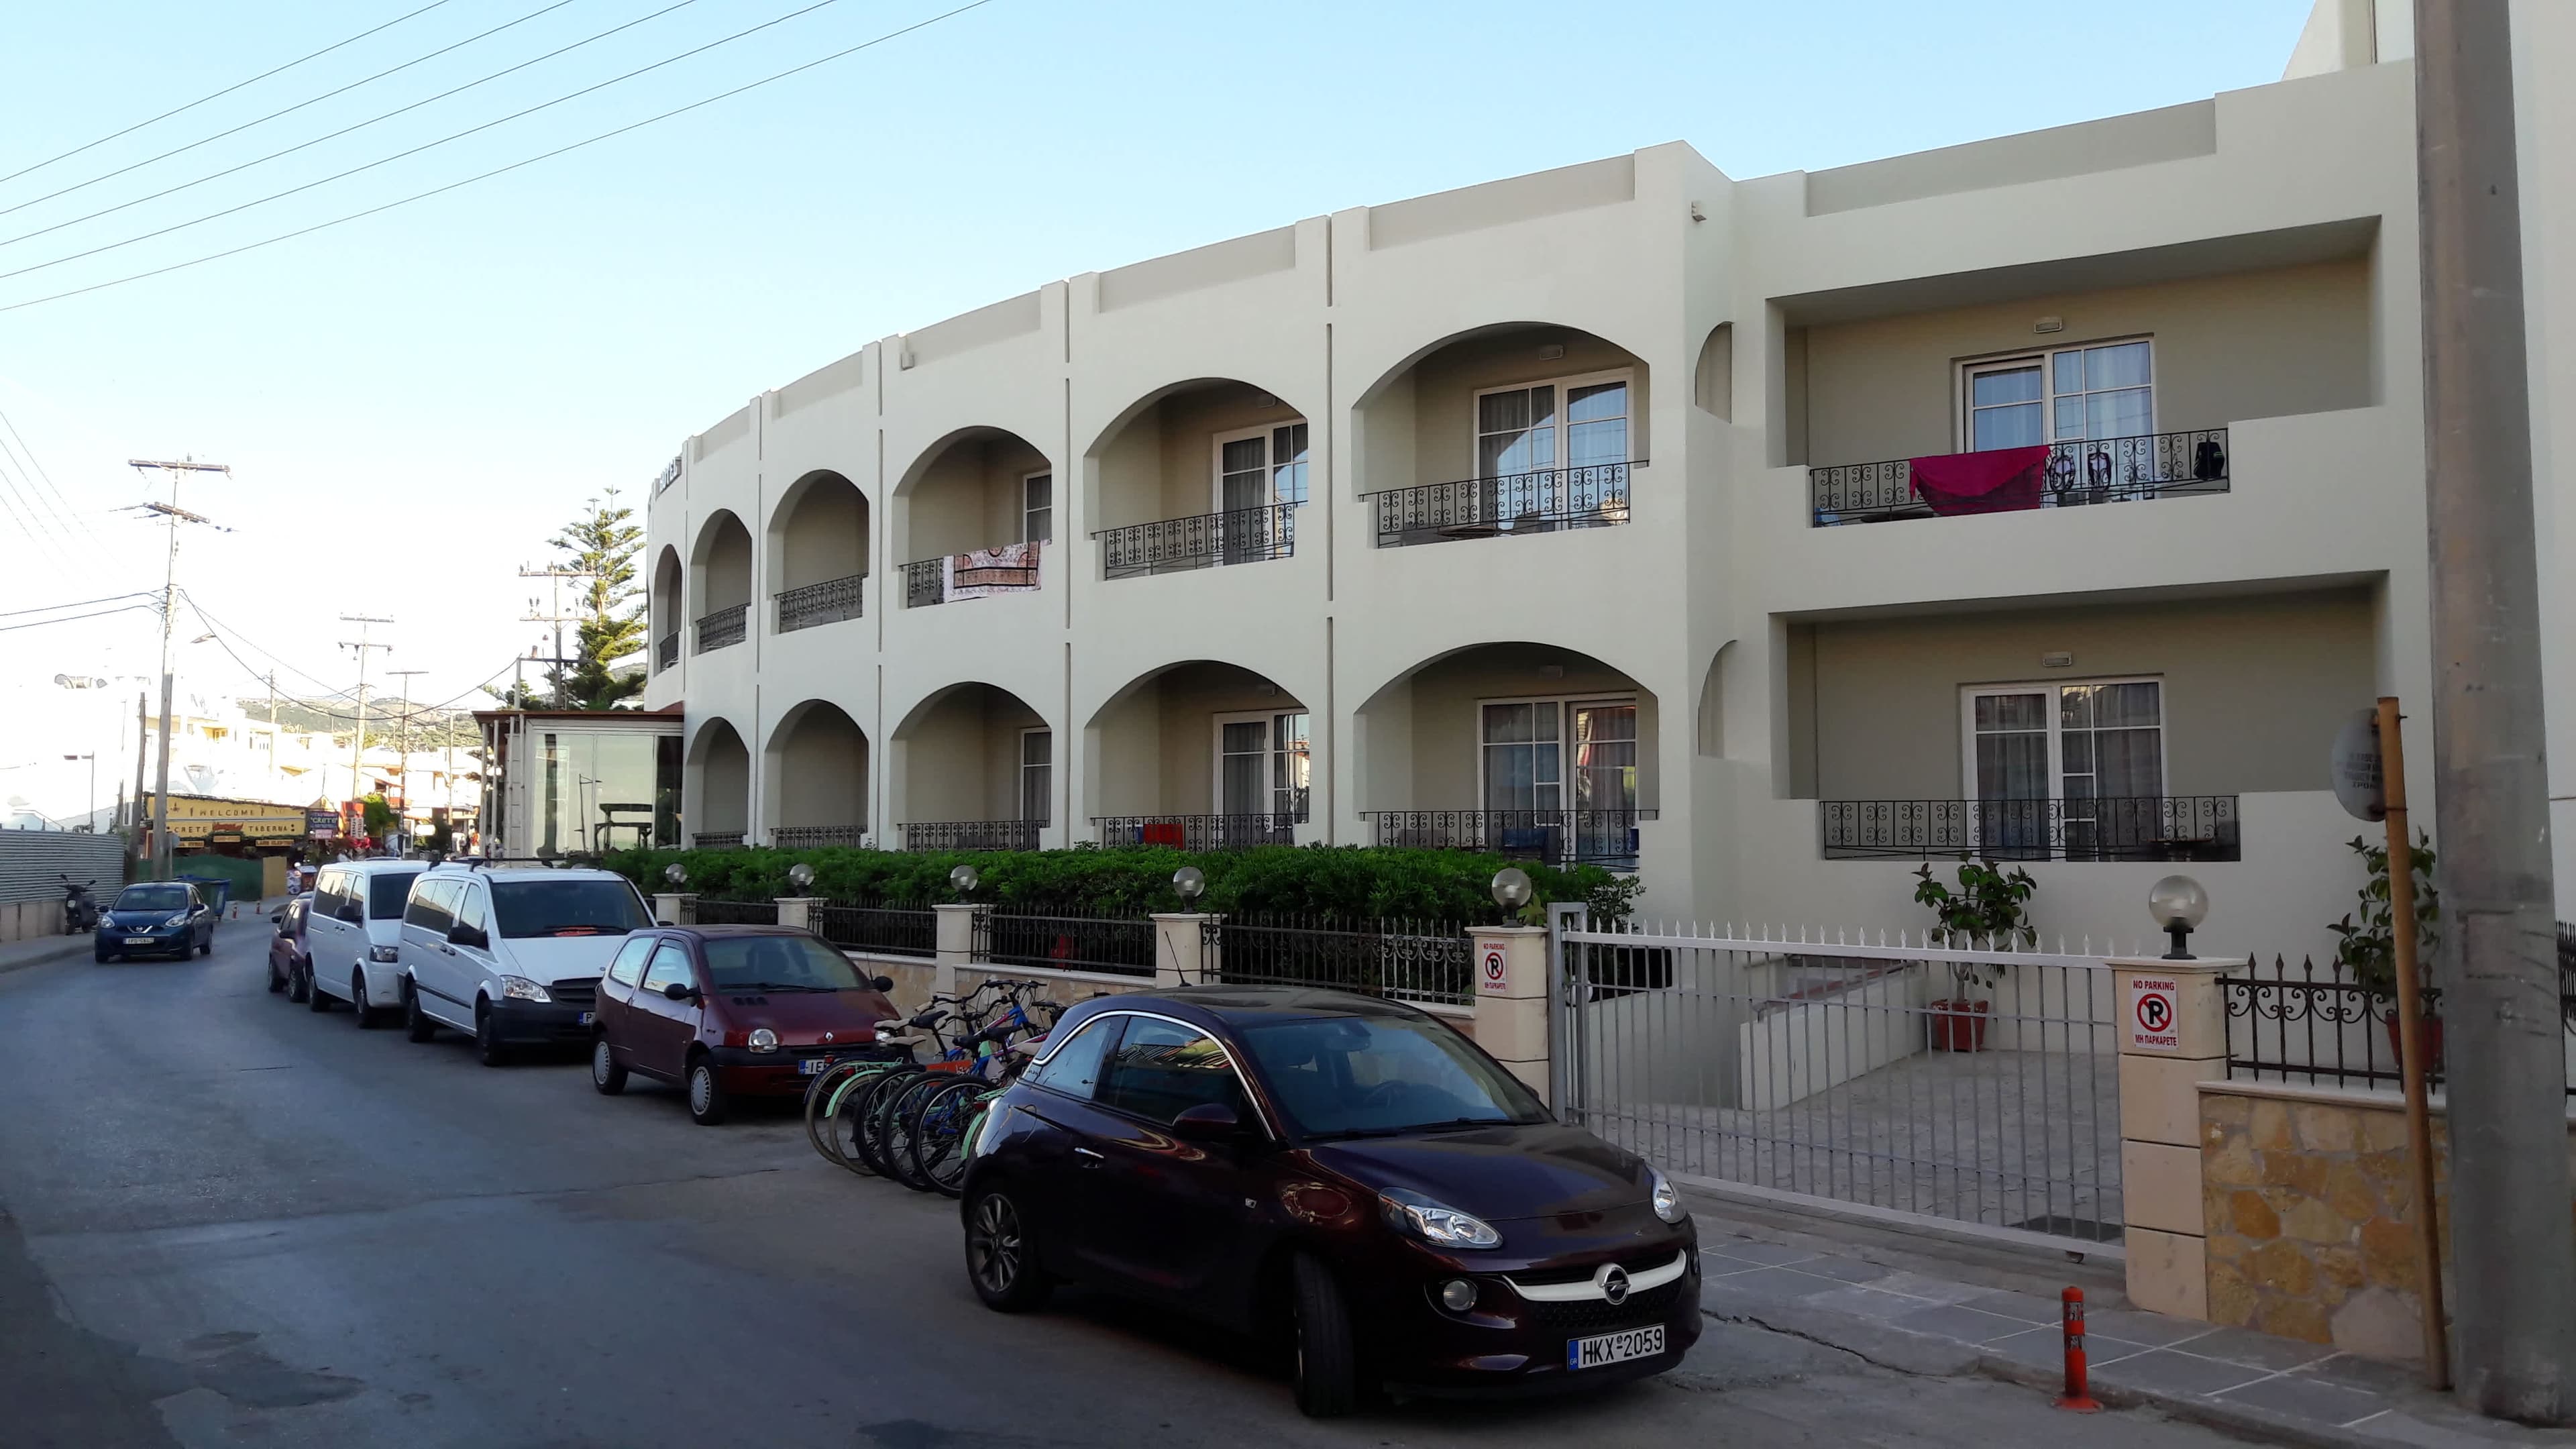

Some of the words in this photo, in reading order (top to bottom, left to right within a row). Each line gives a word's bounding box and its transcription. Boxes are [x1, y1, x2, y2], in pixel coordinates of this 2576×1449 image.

[2133, 980, 2143, 989] NO
[2145, 981, 2174, 991] PARKING
[2135, 1034, 2144, 1043] ΜΗ
[2145, 1035, 2177, 1046] ΠΑΡΚΑΡΕΤΕ
